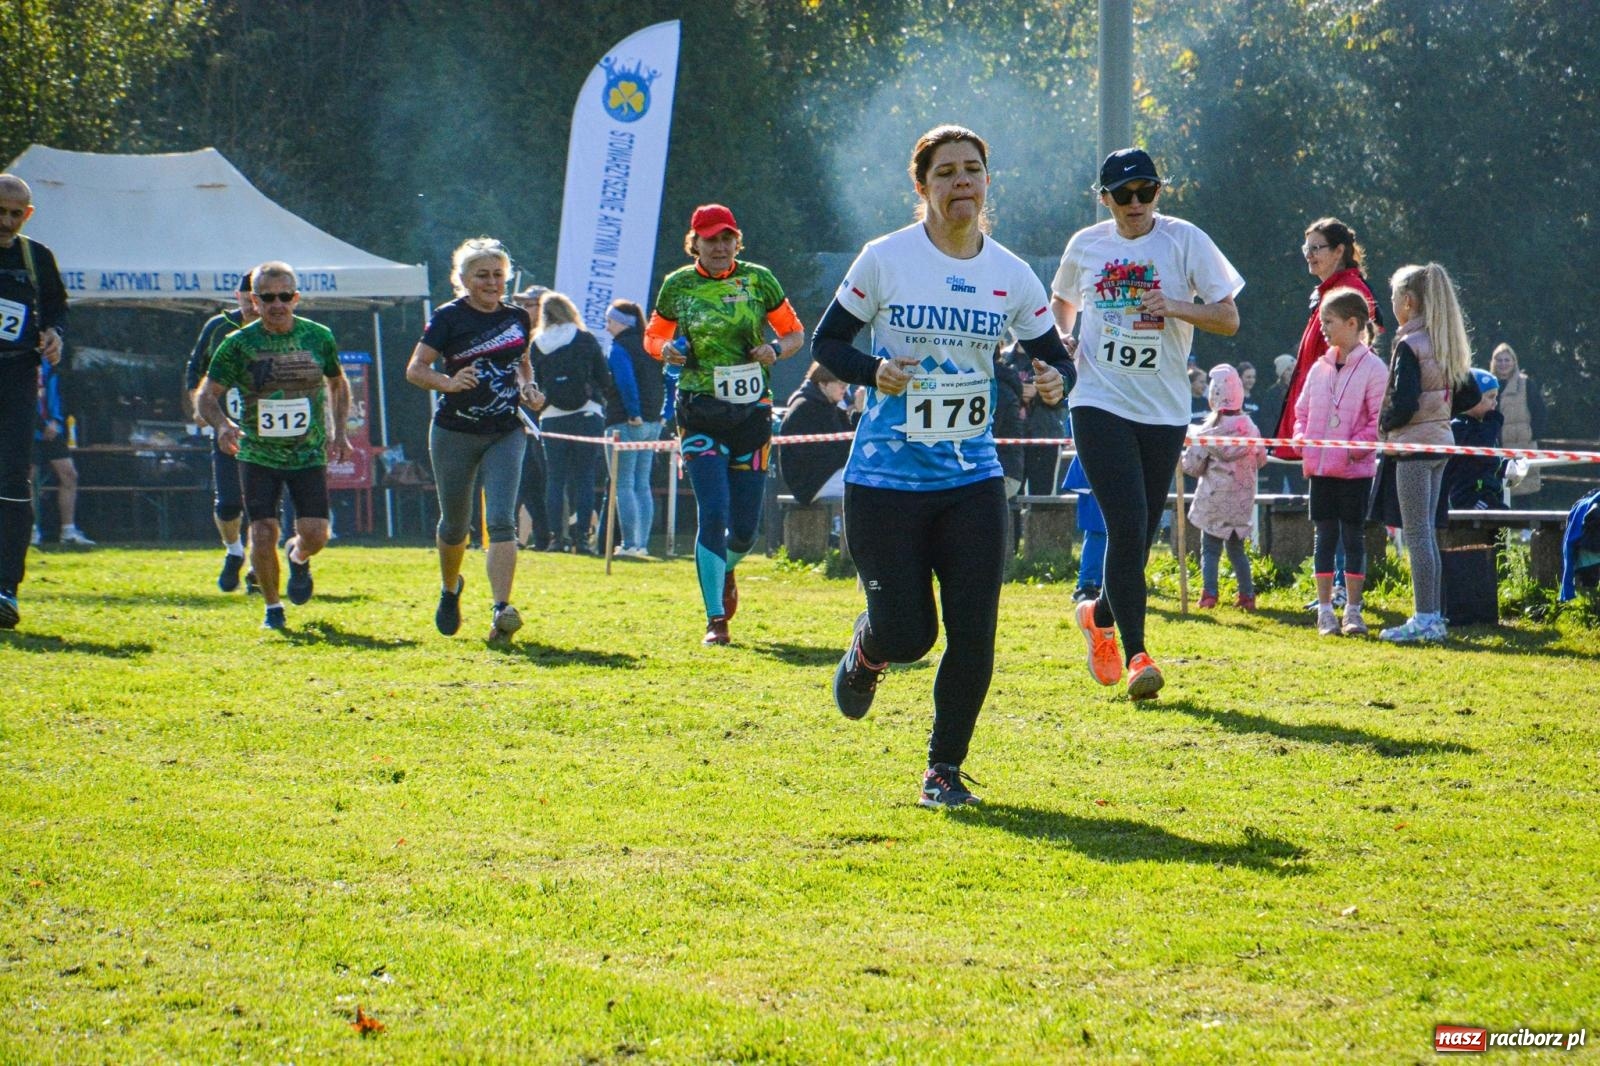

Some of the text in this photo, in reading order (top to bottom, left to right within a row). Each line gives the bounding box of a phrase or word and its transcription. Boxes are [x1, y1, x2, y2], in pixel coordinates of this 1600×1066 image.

[600, 130, 635, 213] STOWARZYSZENIE
[593, 214, 622, 258] AKTYWNI
[590, 259, 616, 278] DLA
[101, 272, 161, 290] AKTYWNI
[174, 273, 200, 290] DLA
[905, 335, 963, 347] EKO-OKNA
[1103, 341, 1157, 369] 192
[718, 377, 760, 397] 180
[230, 400, 238, 413] 1
[914, 396, 986, 429] 178
[261, 412, 307, 430] 312
